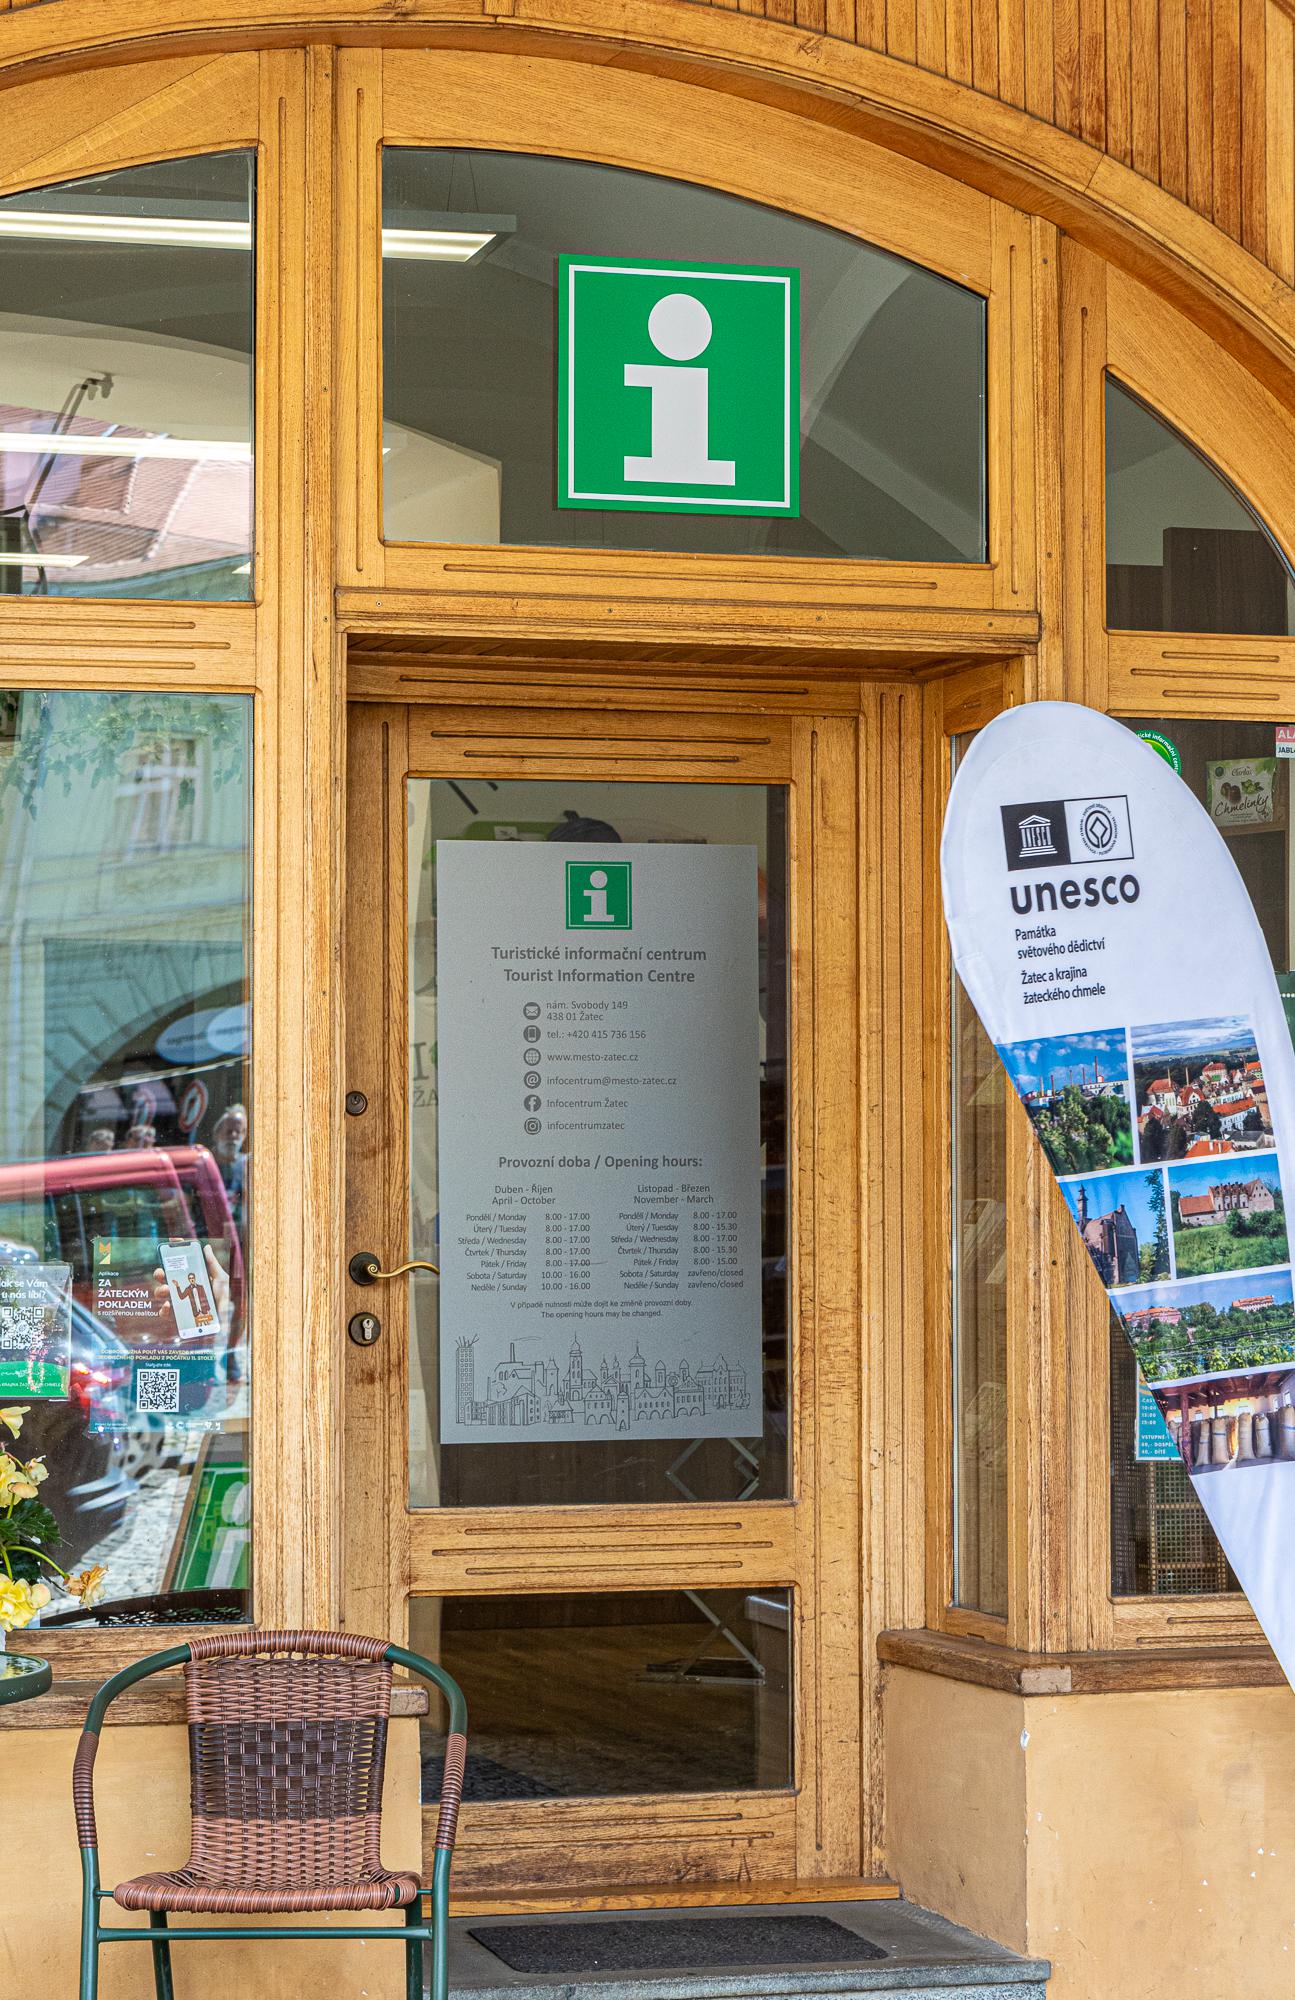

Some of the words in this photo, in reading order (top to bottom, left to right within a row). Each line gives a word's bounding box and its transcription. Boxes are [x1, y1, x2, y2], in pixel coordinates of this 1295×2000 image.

[1010, 874, 1140, 915] unesco
[1015, 925, 1056, 940] Památka
[1018, 943, 1065, 959] světového
[1068, 937, 1105, 953] dědictví
[492, 947, 560, 960] Turistické
[565, 947, 642, 960] informační
[646, 949, 706, 960] centrum
[504, 969, 553, 982] Tourist
[558, 969, 643, 982] Information
[648, 970, 695, 982] Centre
[1021, 970, 1046, 984] Žatec
[1048, 972, 1054, 981] a
[1056, 966, 1087, 982] krajina
[1023, 988, 1070, 1004] žateckého
[1072, 983, 1106, 998] chmele
[572, 1001, 609, 1010] Svobody
[580, 1011, 604, 1020] Žatec
[547, 1076, 677, 1086] infocentrum@mesto-zatec.cz
[547, 1122, 625, 1130] infocentrumzatec
[499, 1156, 554, 1168] Provozní
[559, 1156, 591, 1168] doba
[594, 1156, 600, 1169] /
[605, 1156, 658, 1169] Opening
[663, 1156, 702, 1167] hours:
[495, 1186, 523, 1194] Duben
[532, 1184, 553, 1194] Říjen
[638, 1185, 673, 1193] Listopad
[682, 1184, 710, 1192] Březen
[492, 1196, 513, 1205] April
[687, 1195, 714, 1203] March
[498, 1214, 526, 1223] Monday
[650, 1212, 678, 1221] Monday
[474, 1224, 492, 1234] Úterý
[500, 1225, 526, 1234] Tuesday
[626, 1223, 645, 1233] Úterý
[652, 1224, 678, 1232] Tuesday
[488, 1237, 527, 1245] Wednesday
[640, 1235, 678, 1244] Wednesday
[465, 1248, 489, 1256] Čtvrtek
[496, 1249, 527, 1257] Thursday
[618, 1246, 642, 1254] Čtvrtek
[649, 1247, 678, 1256] Thursday
[507, 1260, 527, 1269] Friday
[659, 1259, 678, 1267] Friday
[498, 1272, 527, 1280] Saturday
[650, 1270, 678, 1279] Saturday
[688, 1269, 744, 1277] zavřeno/closed
[26, 1279, 48, 1287] Vám
[655, 1282, 678, 1290] Sunday
[502, 1284, 527, 1292] Sunday
[10, 1289, 26, 1298] nás
[98, 1288, 148, 1298] ŽATECKÝM
